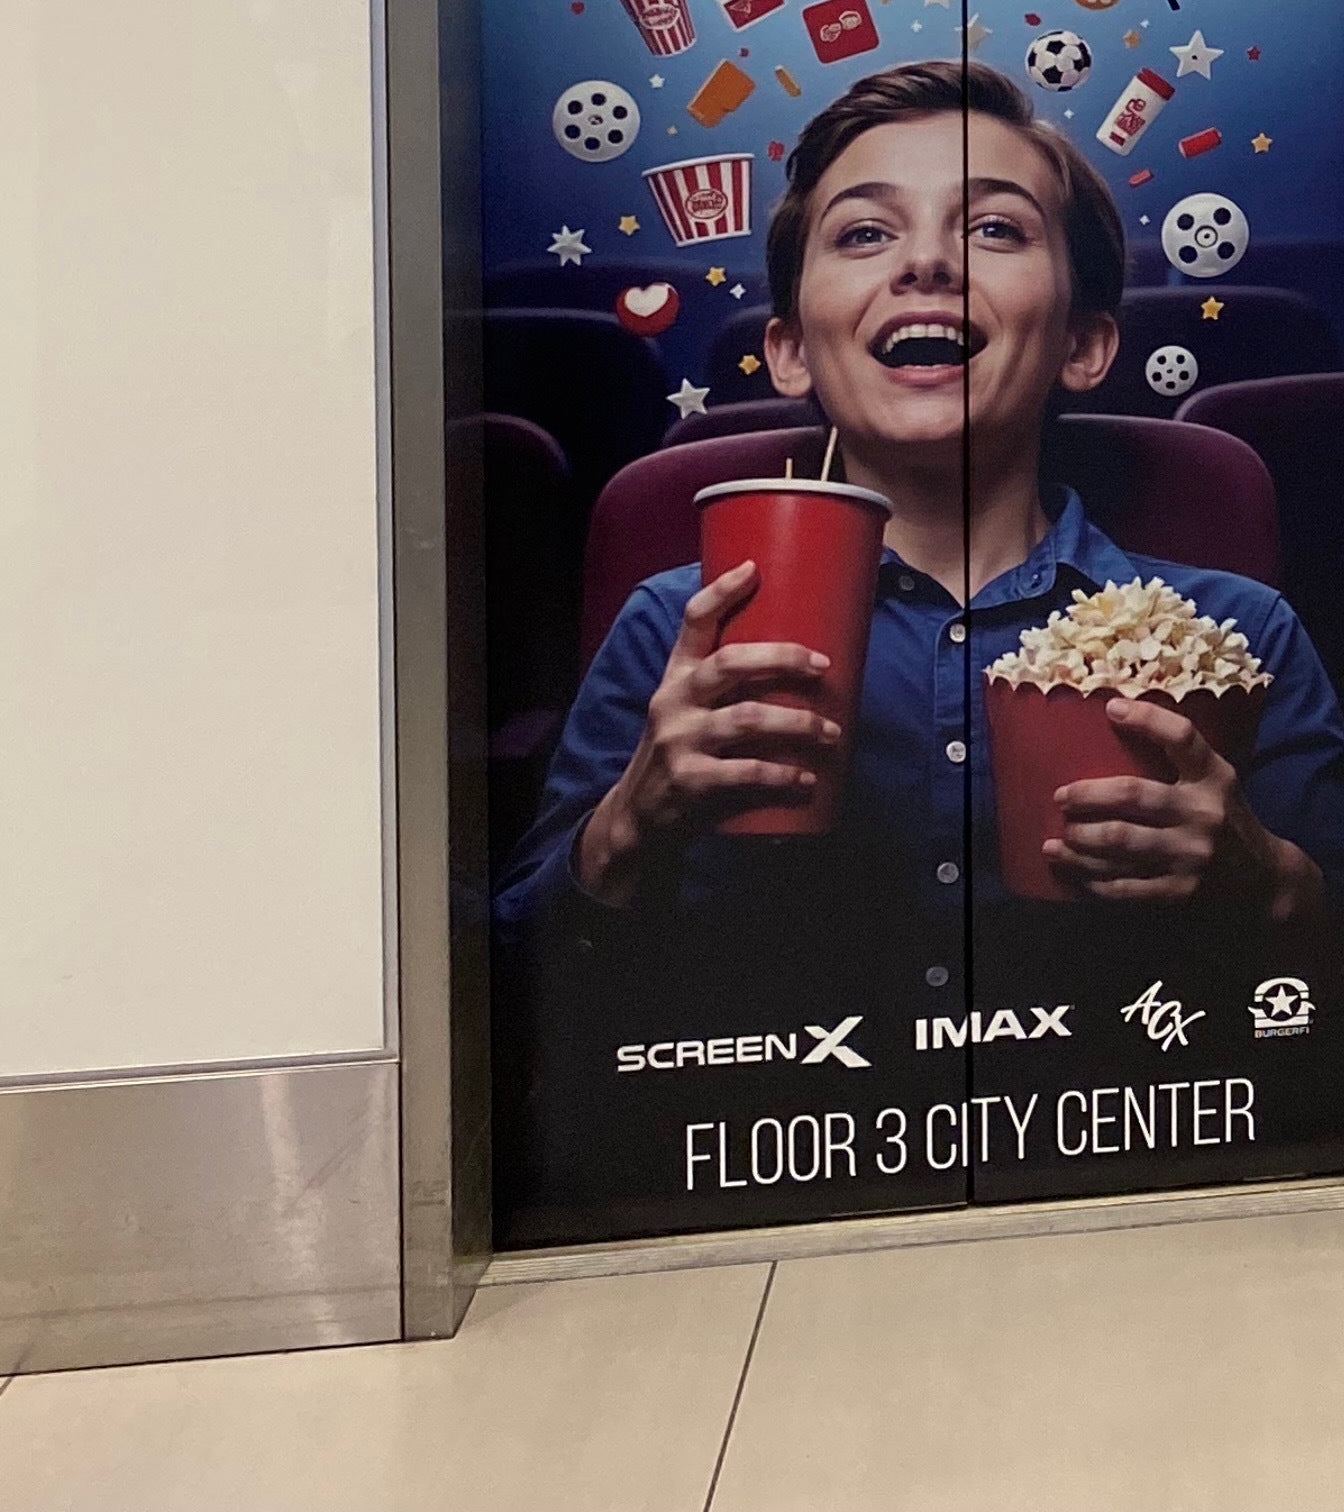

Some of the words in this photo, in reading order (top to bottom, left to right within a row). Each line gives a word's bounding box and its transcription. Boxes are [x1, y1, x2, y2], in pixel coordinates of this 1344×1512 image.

[616, 1015, 873, 1073] SCREENX
[915, 1004, 1073, 1051] IMAX
[1254, 1026, 1310, 1039] BURGERFI
[685, 1109, 858, 1191] FLOOR
[876, 1108, 908, 1175] 3
[926, 1092, 1040, 1172] CITY
[1056, 1076, 1257, 1158] CENTER
